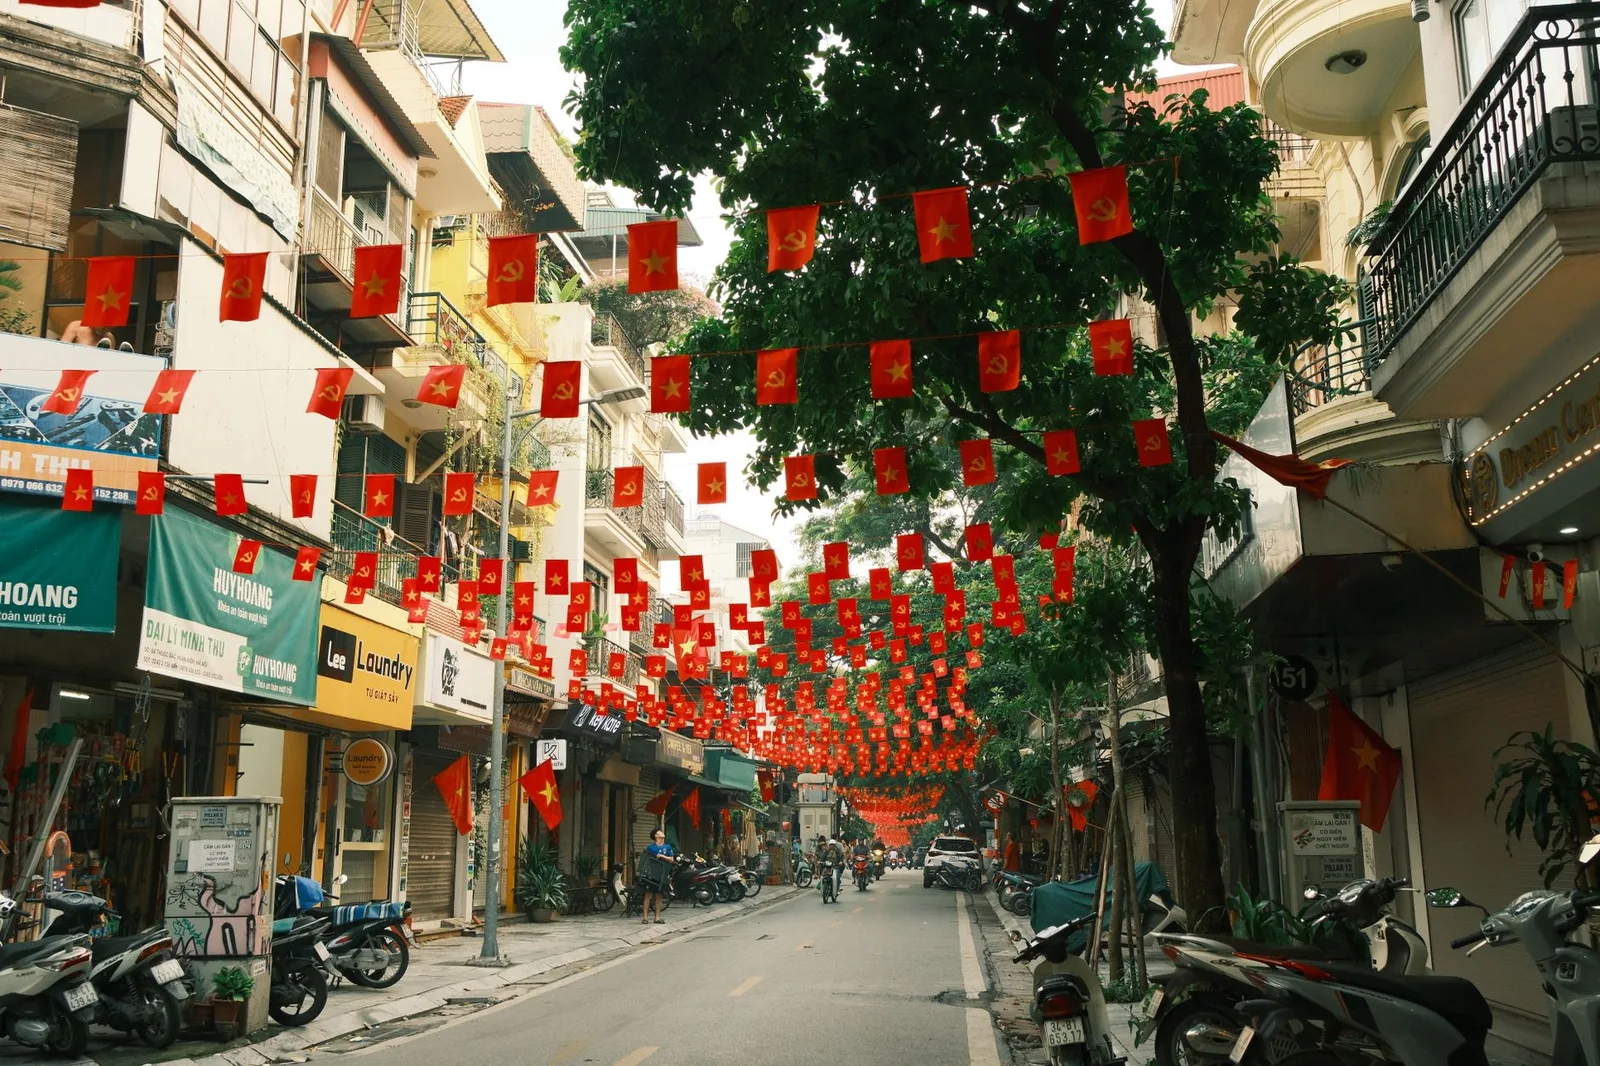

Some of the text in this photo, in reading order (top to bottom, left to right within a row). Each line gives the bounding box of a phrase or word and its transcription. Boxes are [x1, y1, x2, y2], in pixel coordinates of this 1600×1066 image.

[45, 482, 63, 493] 632
[95, 488, 111, 499] 152
[23, 612, 46, 625] vượt
[48, 613, 66, 626] trội
[180, 629, 205, 653] MINH
[208, 636, 225, 658] THU
[327, 640, 346, 671] Lee
[356, 640, 413, 691] Laundry
[1281, 667, 1307, 689] 51
[347, 753, 383, 763] Laundry
[1048, 1030, 1082, 1045] 653.17
